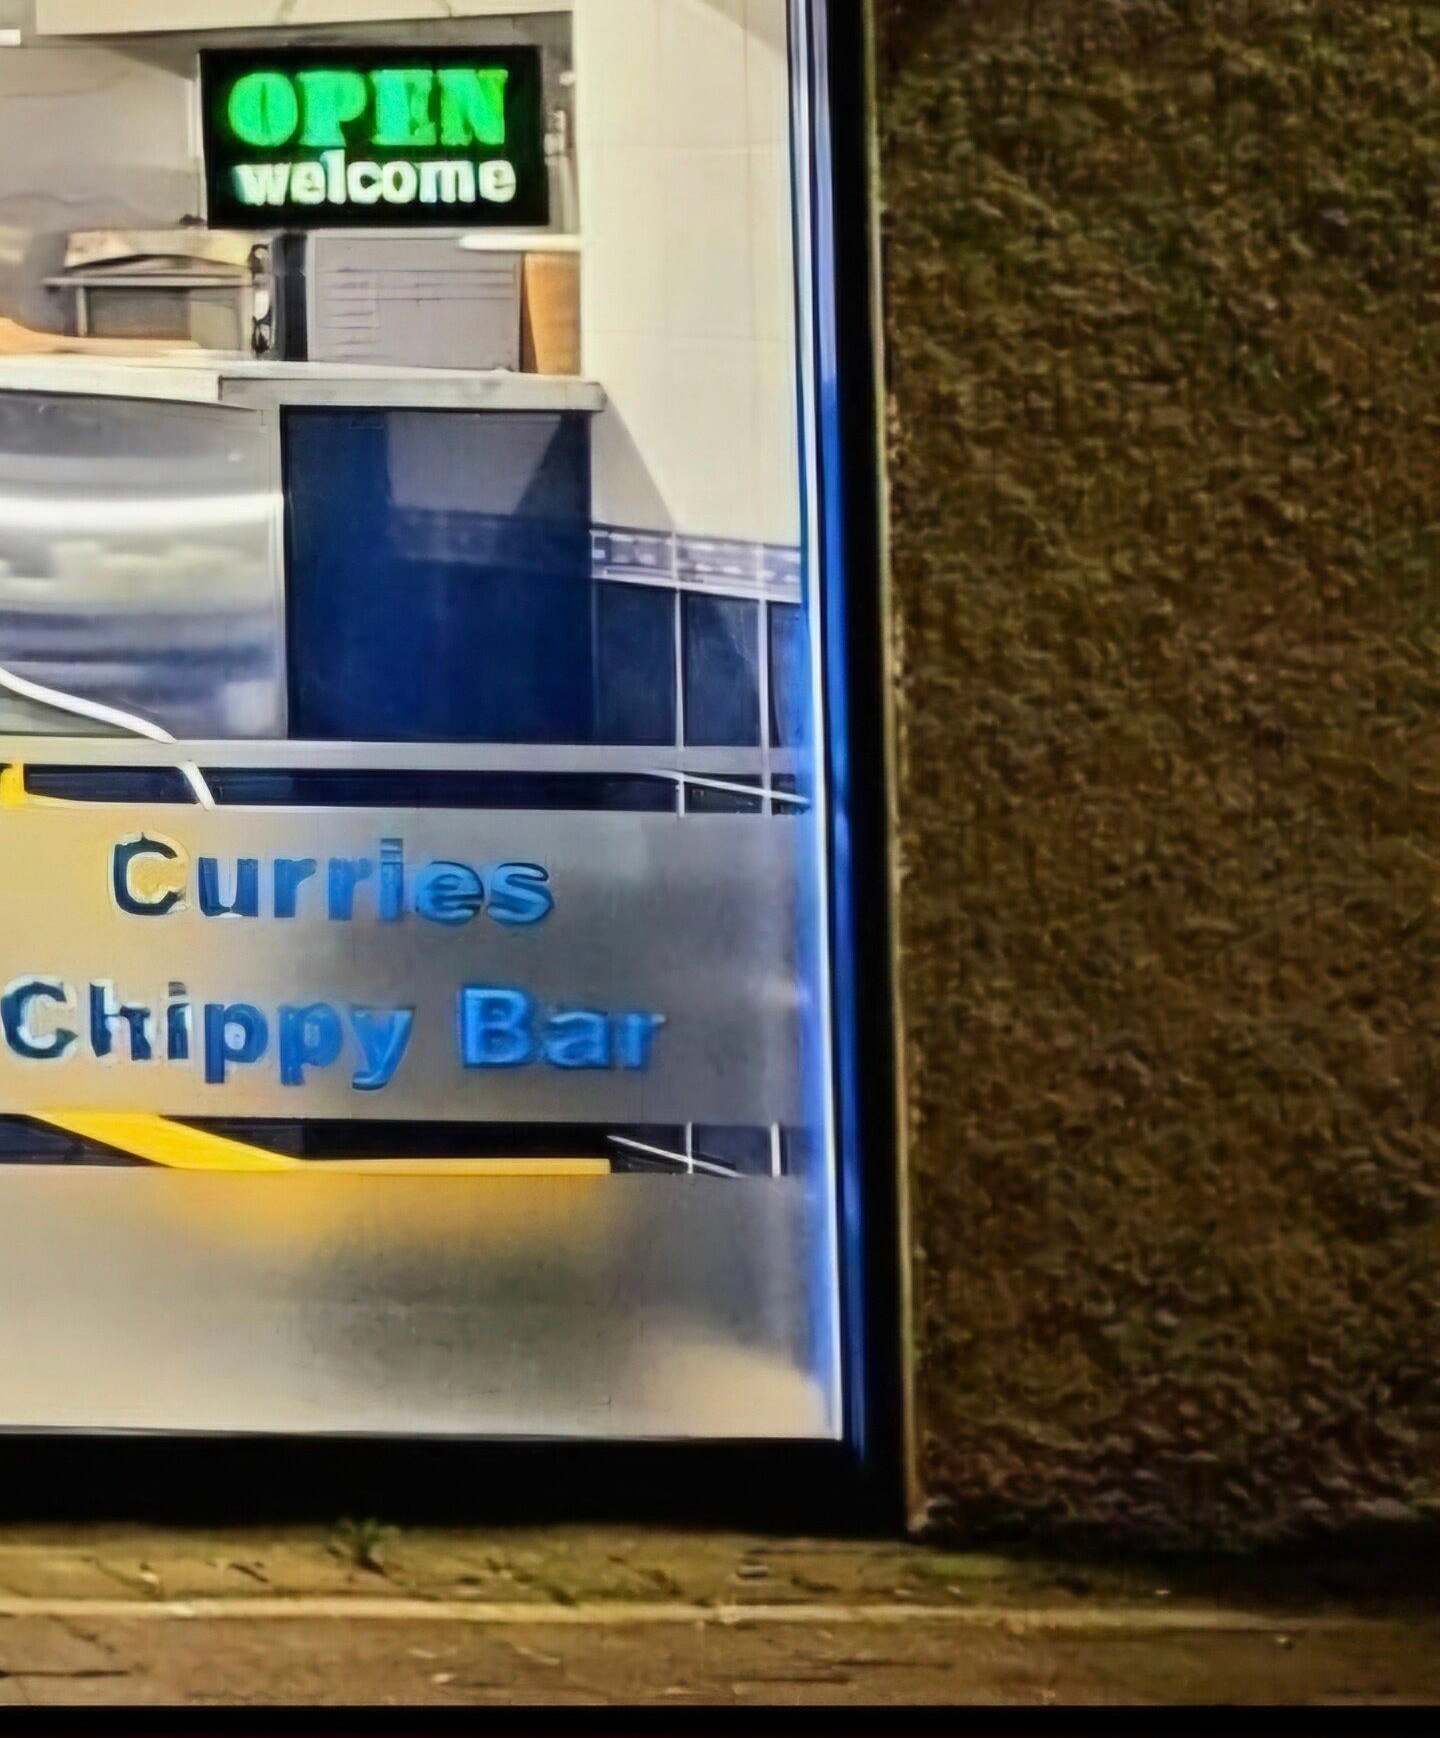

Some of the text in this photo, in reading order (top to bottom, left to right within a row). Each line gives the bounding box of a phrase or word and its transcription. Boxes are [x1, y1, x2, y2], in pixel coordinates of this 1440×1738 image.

[227, 68, 509, 147] OPEN
[233, 148, 517, 206] welcome
[108, 833, 555, 926] Curries
[0, 978, 666, 1090] Chippy Bar
